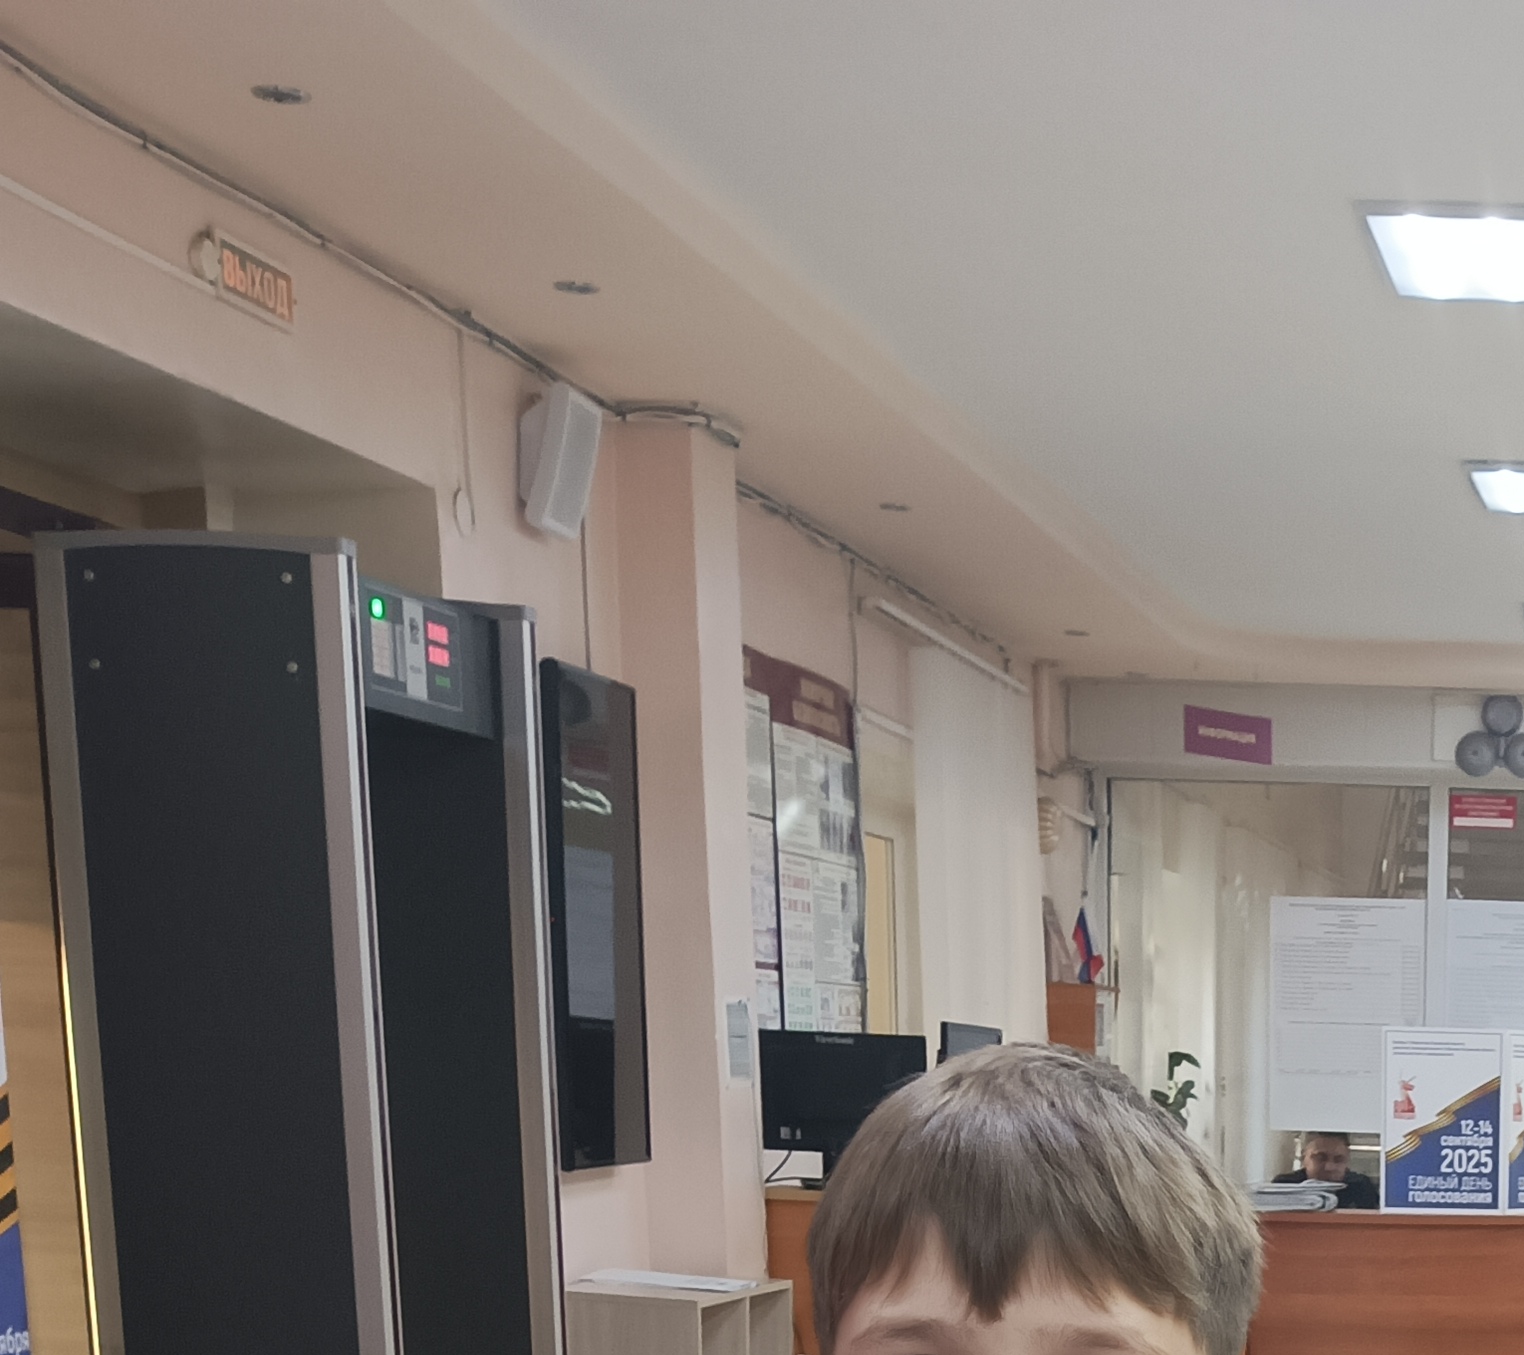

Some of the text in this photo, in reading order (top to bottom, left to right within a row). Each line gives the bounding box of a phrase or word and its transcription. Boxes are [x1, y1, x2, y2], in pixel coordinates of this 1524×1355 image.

[222, 248, 290, 318] ВЫХОД
[1460, 1119, 1493, 1135] 12-14
[1440, 1148, 1493, 1174] 2025
[1408, 1174, 1493, 1191] ЕДИНЫЙ ДЕНЬ
